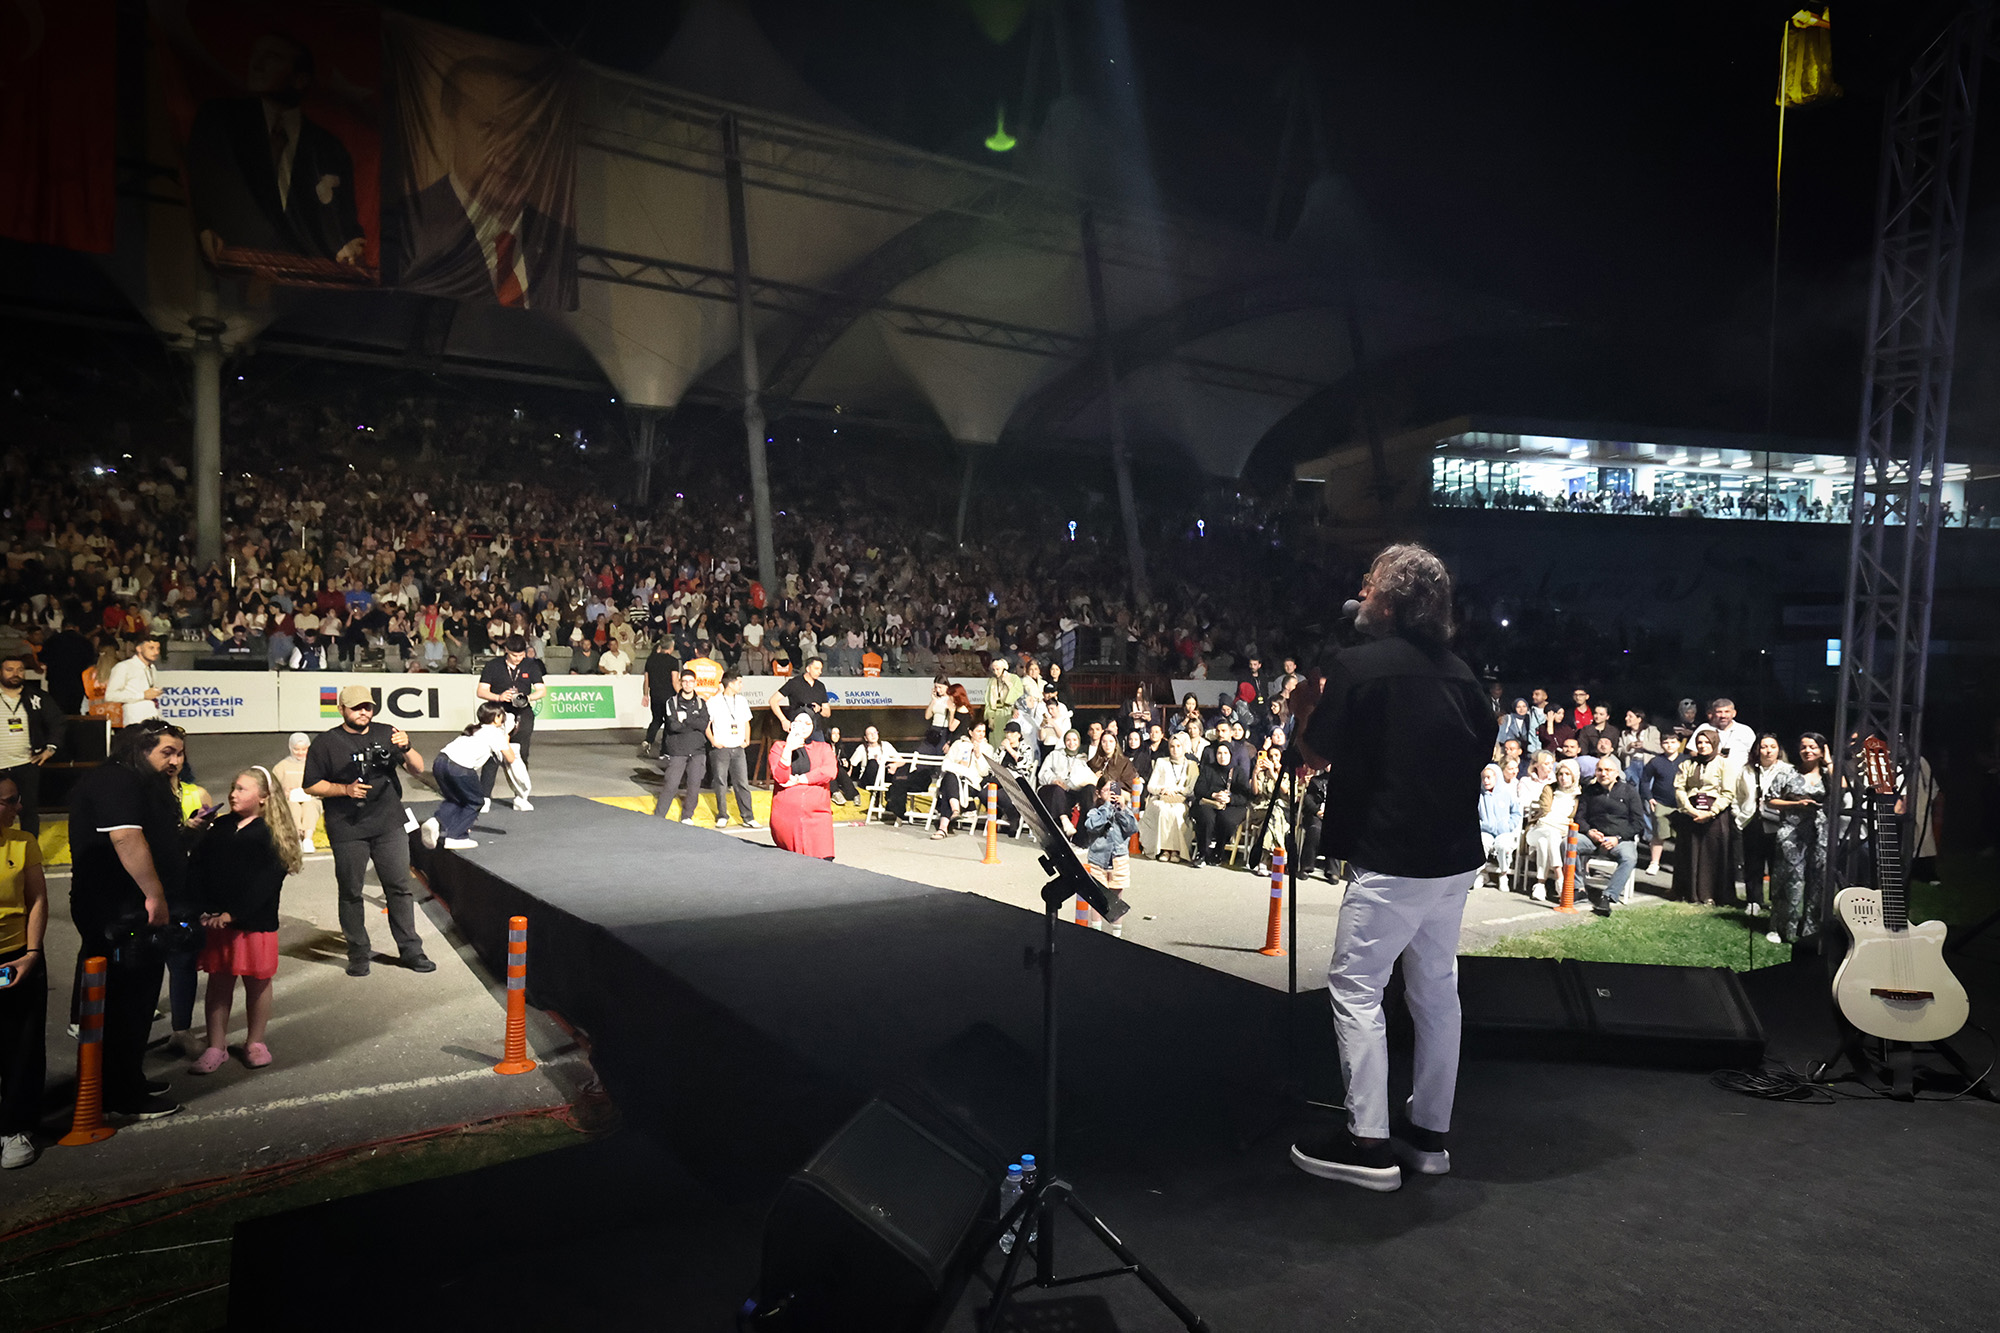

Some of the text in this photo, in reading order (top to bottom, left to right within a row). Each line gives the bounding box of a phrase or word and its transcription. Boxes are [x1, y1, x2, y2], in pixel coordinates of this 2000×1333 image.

[550, 691, 604, 702] SAKARYA
[844, 690, 881, 698] SAKARYA
[159, 695, 244, 708] ÜYÜKŞEHİR
[845, 696, 893, 705] BÜYÜKŞEHİR
[161, 706, 235, 718] ELEDİYESİ
[550, 701, 597, 713] TÜRKİYE
